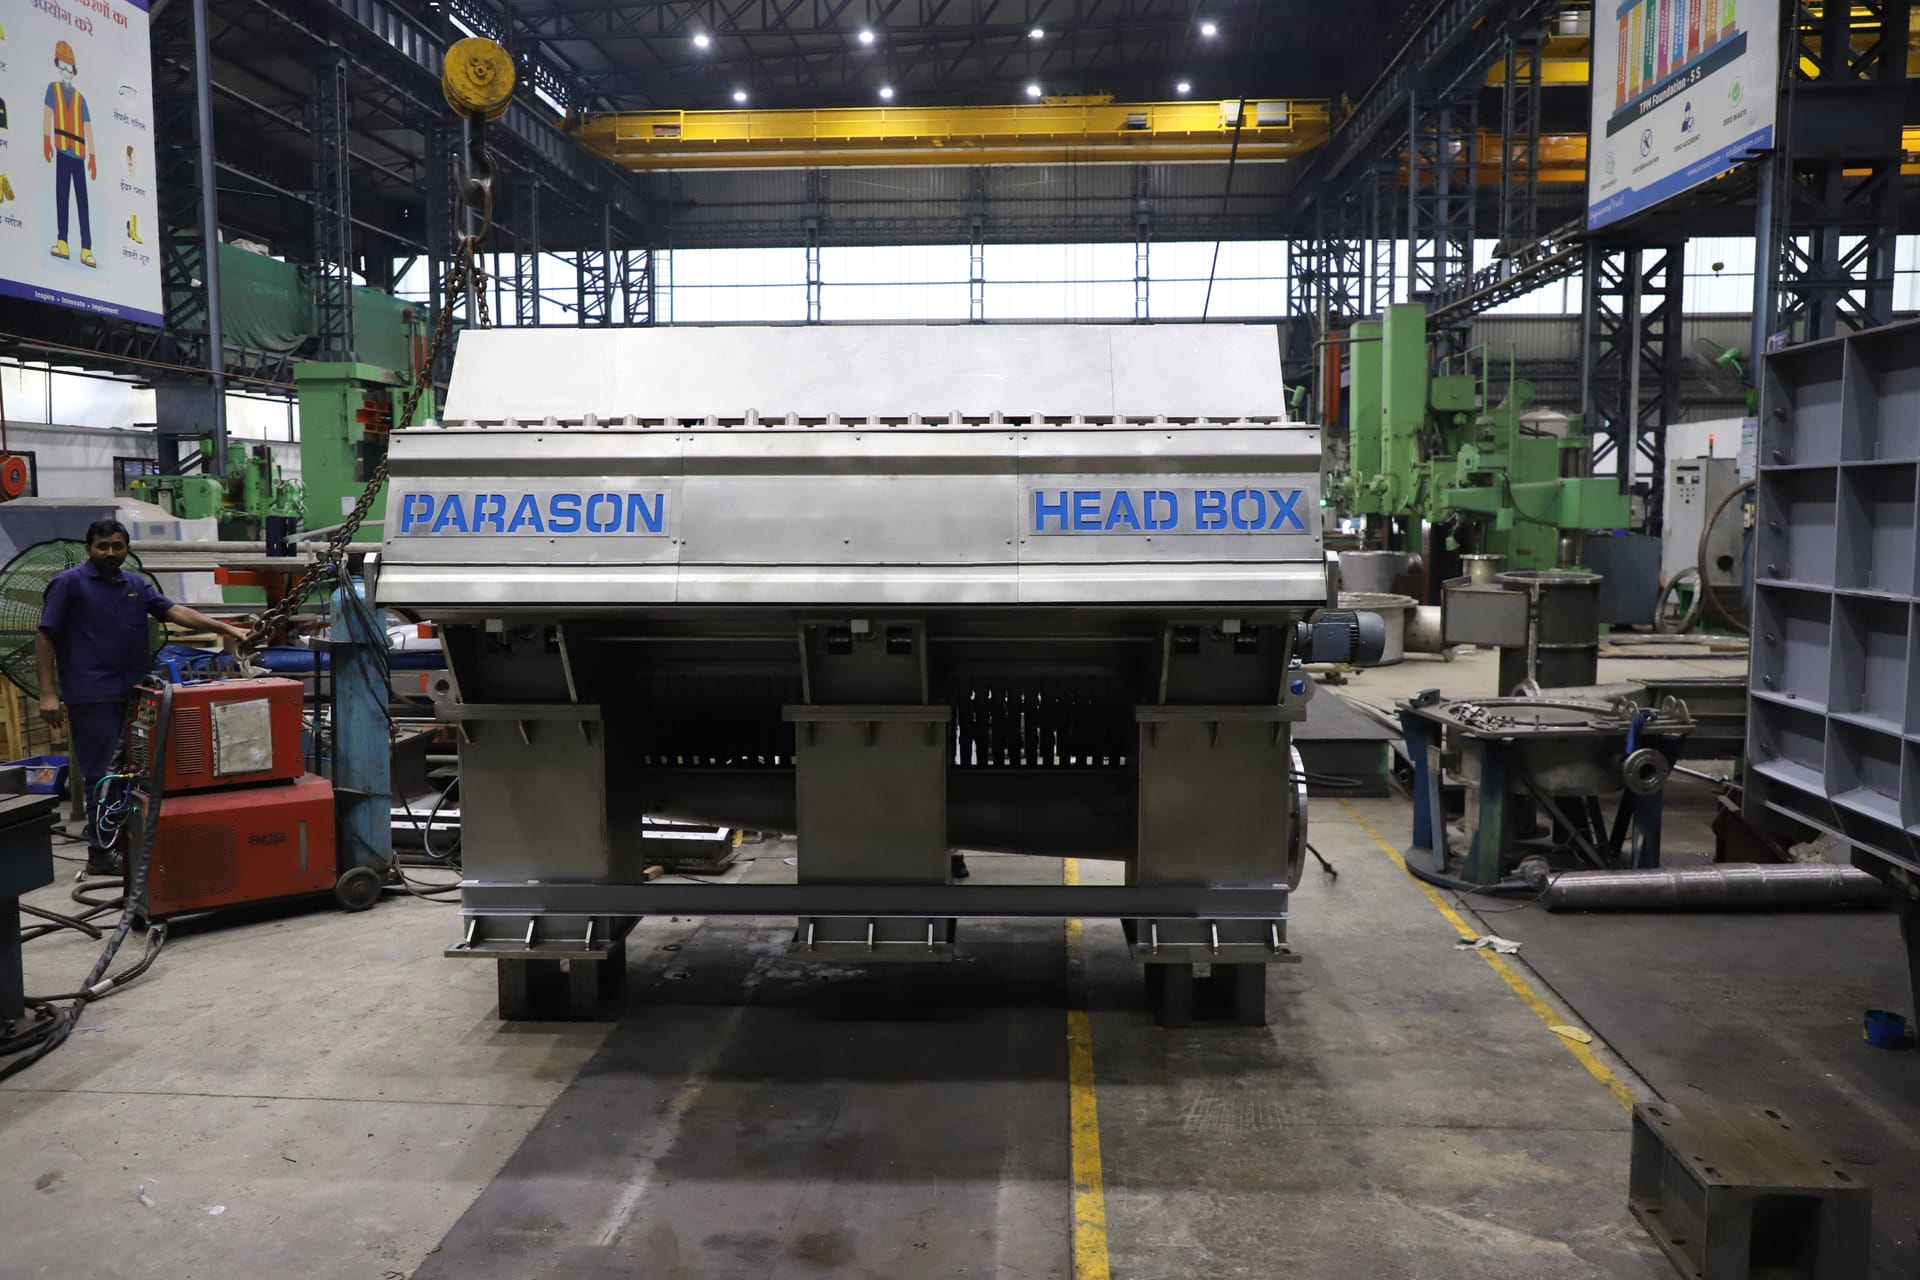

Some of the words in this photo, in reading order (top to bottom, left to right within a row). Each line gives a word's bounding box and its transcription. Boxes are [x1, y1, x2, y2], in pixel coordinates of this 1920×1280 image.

[112, 9, 128, 29] का
[1639, 96, 1652, 115] TPM
[1652, 77, 1687, 108] Foundation
[1690, 68, 1696, 83] 5
[1695, 66, 1702, 80] S
[34, 290, 55, 302] Inspire
[61, 296, 86, 308] Innovate
[401, 493, 665, 533] PARASON
[1035, 490, 1179, 531] HEAD
[1194, 489, 1305, 531] BOX
